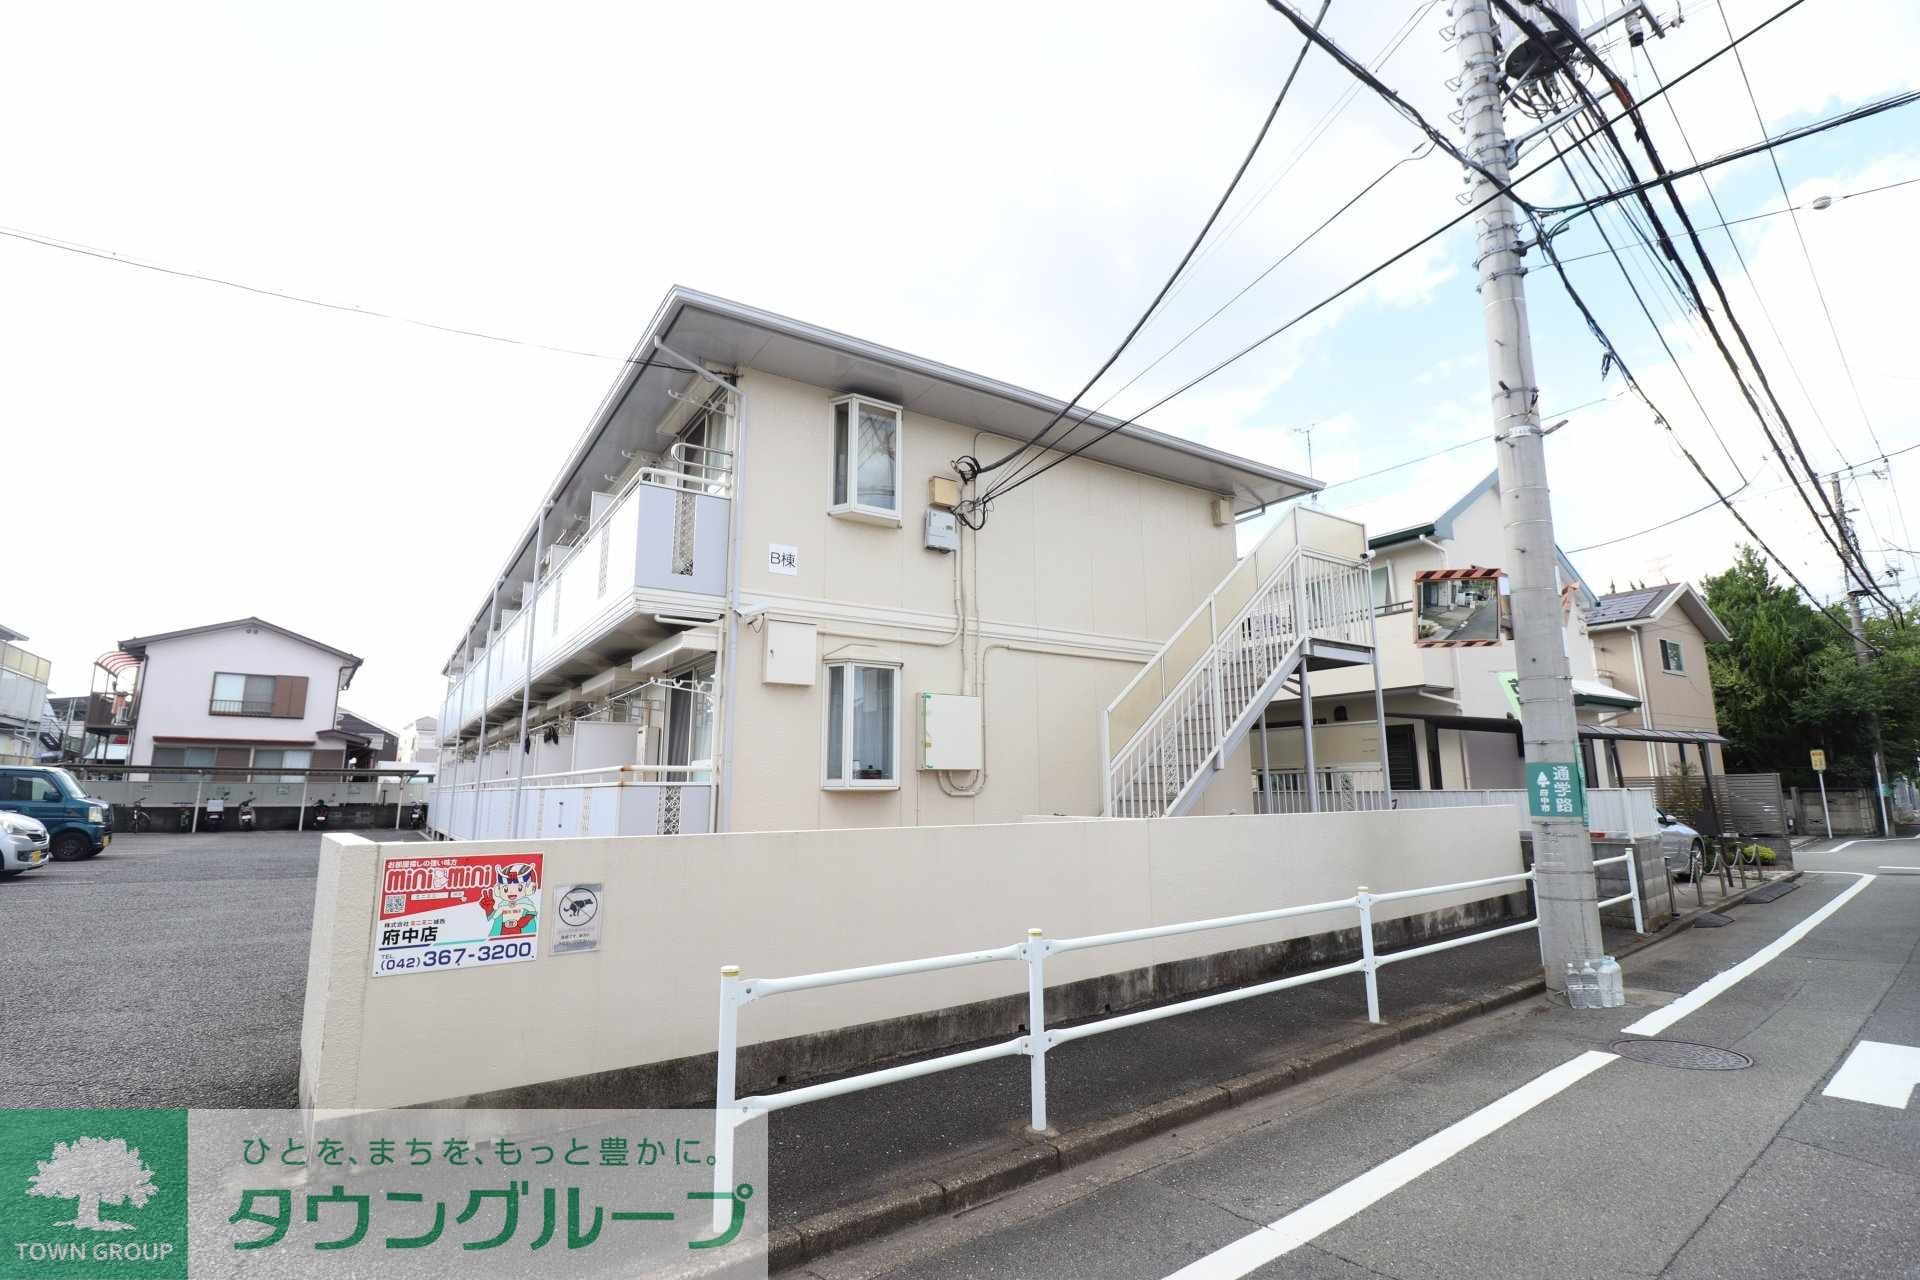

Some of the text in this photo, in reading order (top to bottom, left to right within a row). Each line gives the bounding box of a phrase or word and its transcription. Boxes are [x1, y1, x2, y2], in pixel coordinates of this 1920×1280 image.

[770, 551, 796, 568] B棟
[1552, 766, 1573, 813] 通学路
[386, 864, 491, 892] mini mini
[382, 926, 438, 945] 府中店
